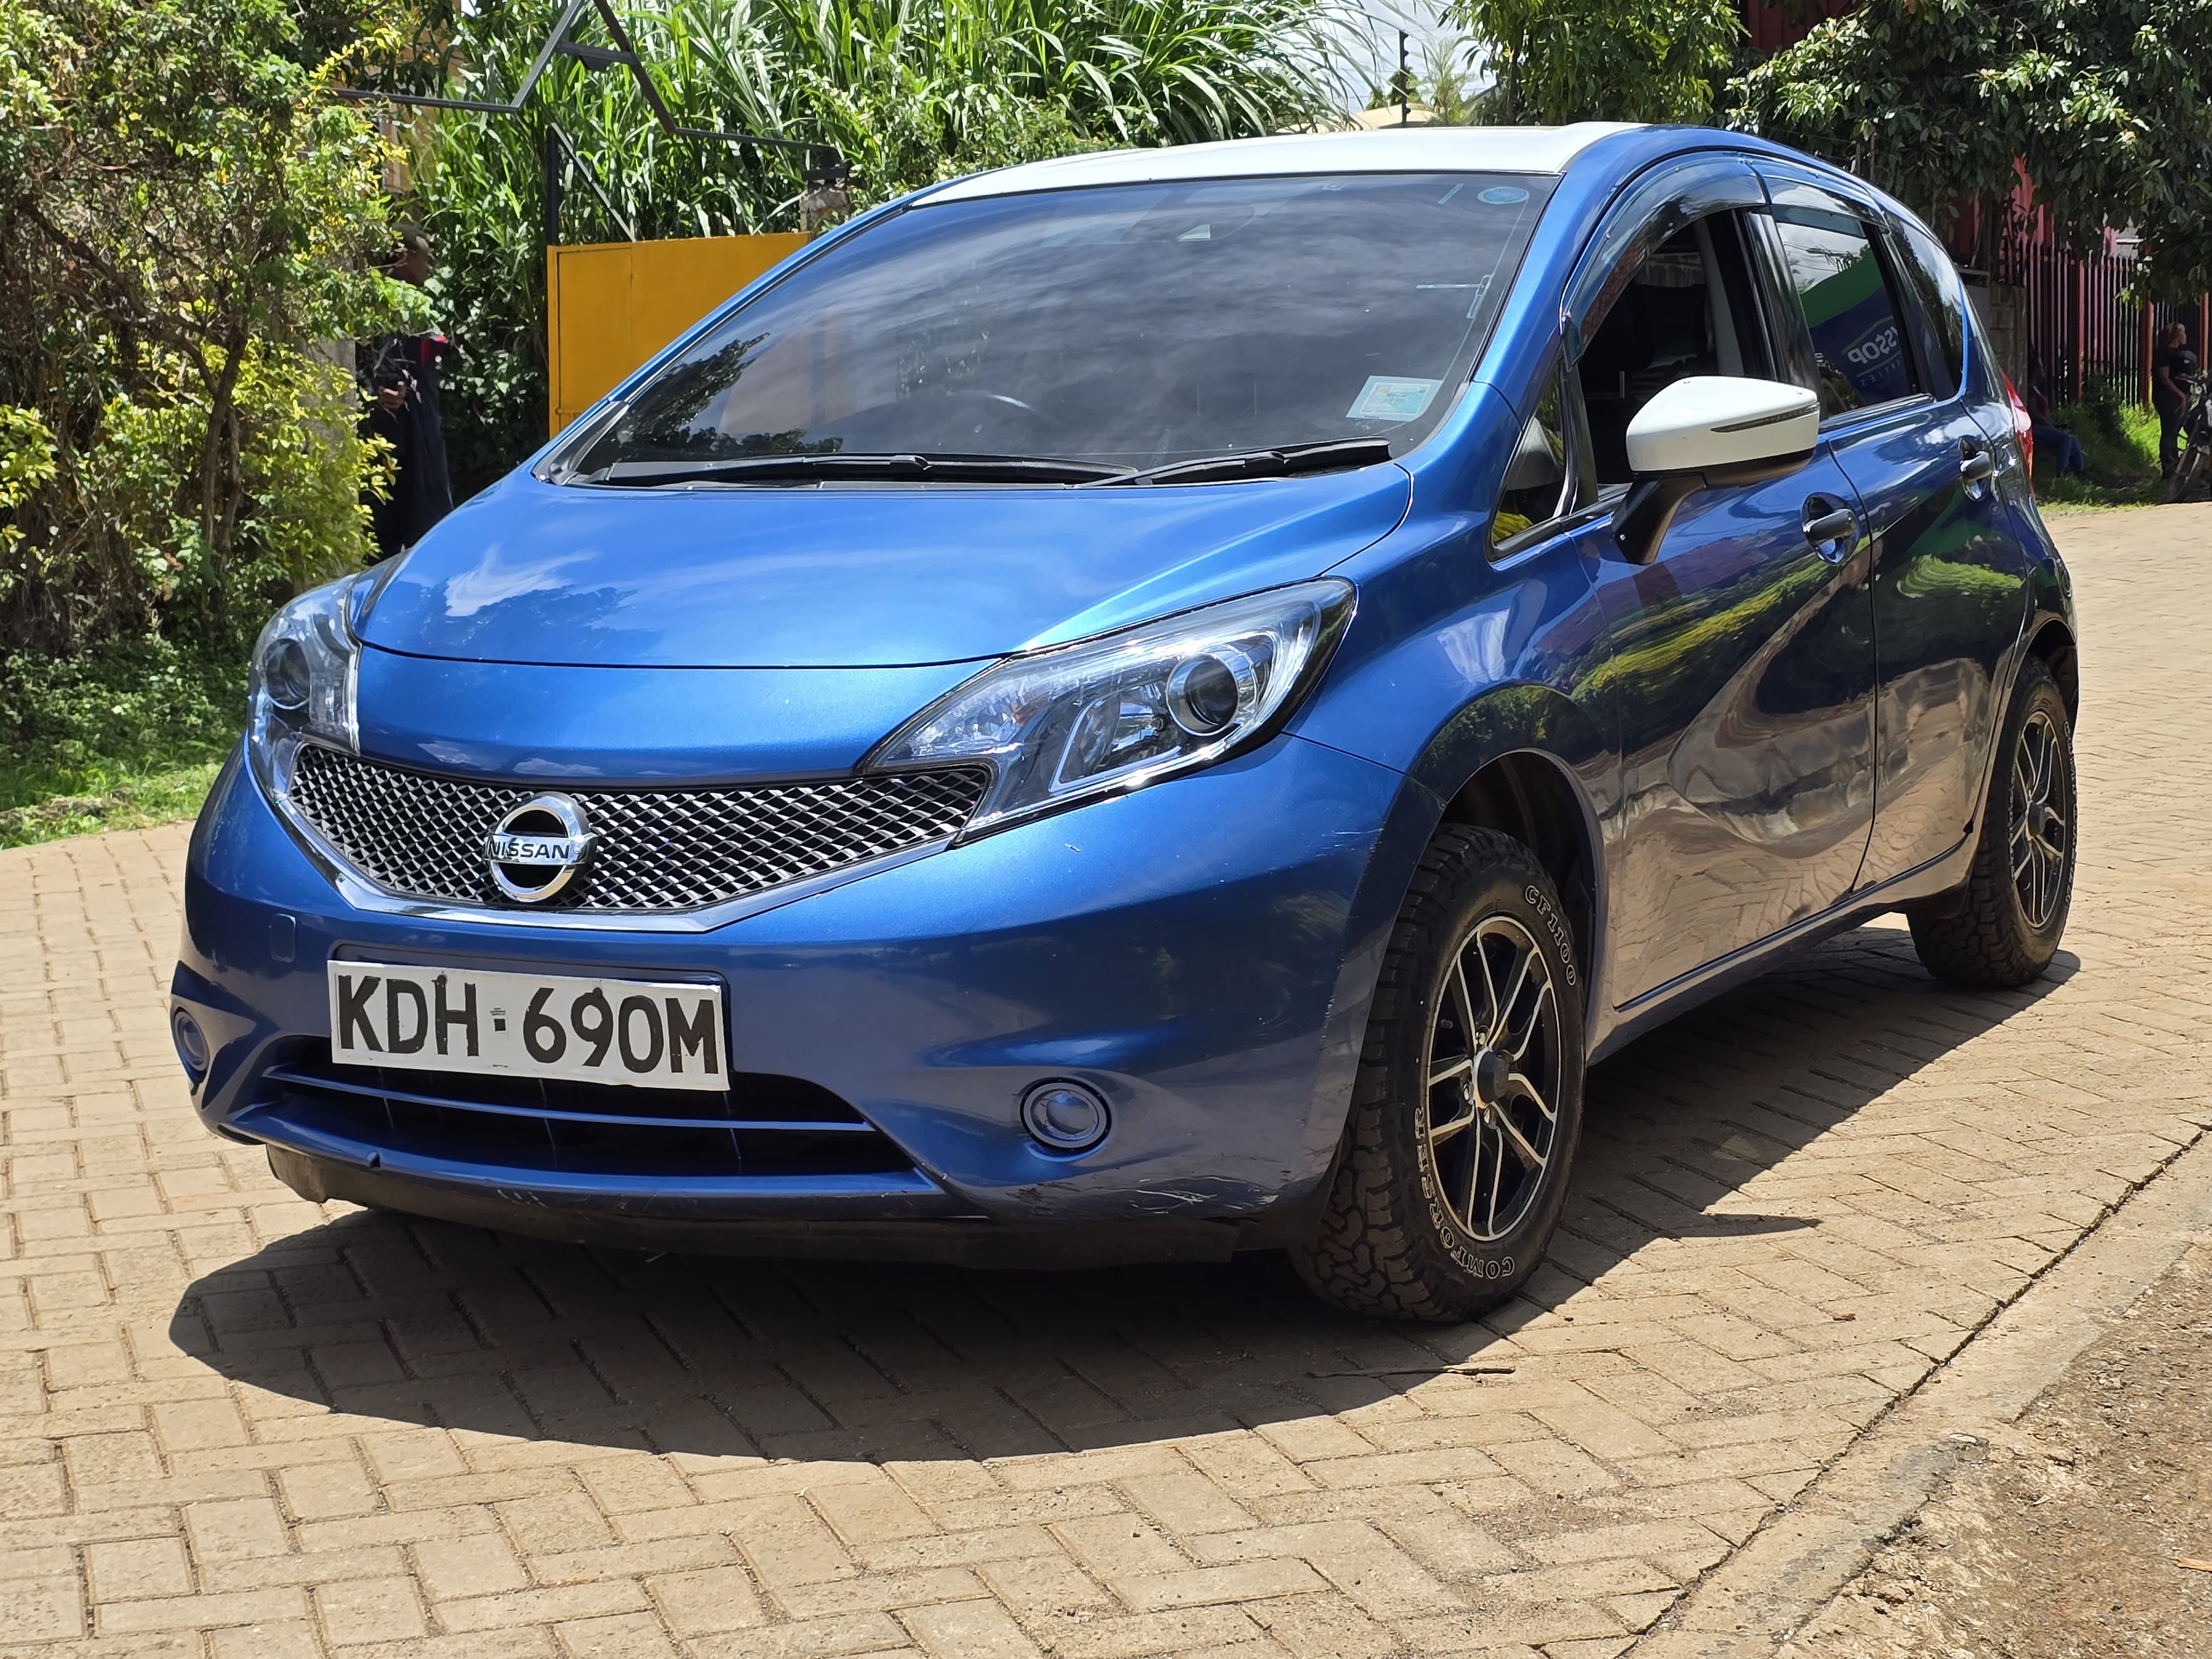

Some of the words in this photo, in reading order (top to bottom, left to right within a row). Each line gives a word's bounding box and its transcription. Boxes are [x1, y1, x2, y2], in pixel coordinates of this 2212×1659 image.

[487, 838, 570, 859] NISSAN
[1525, 885, 1576, 986] CF1100
[338, 974, 479, 1057] KDH
[523, 987, 719, 1074] 690M
[1415, 1107, 1515, 1280] COMFORSER
